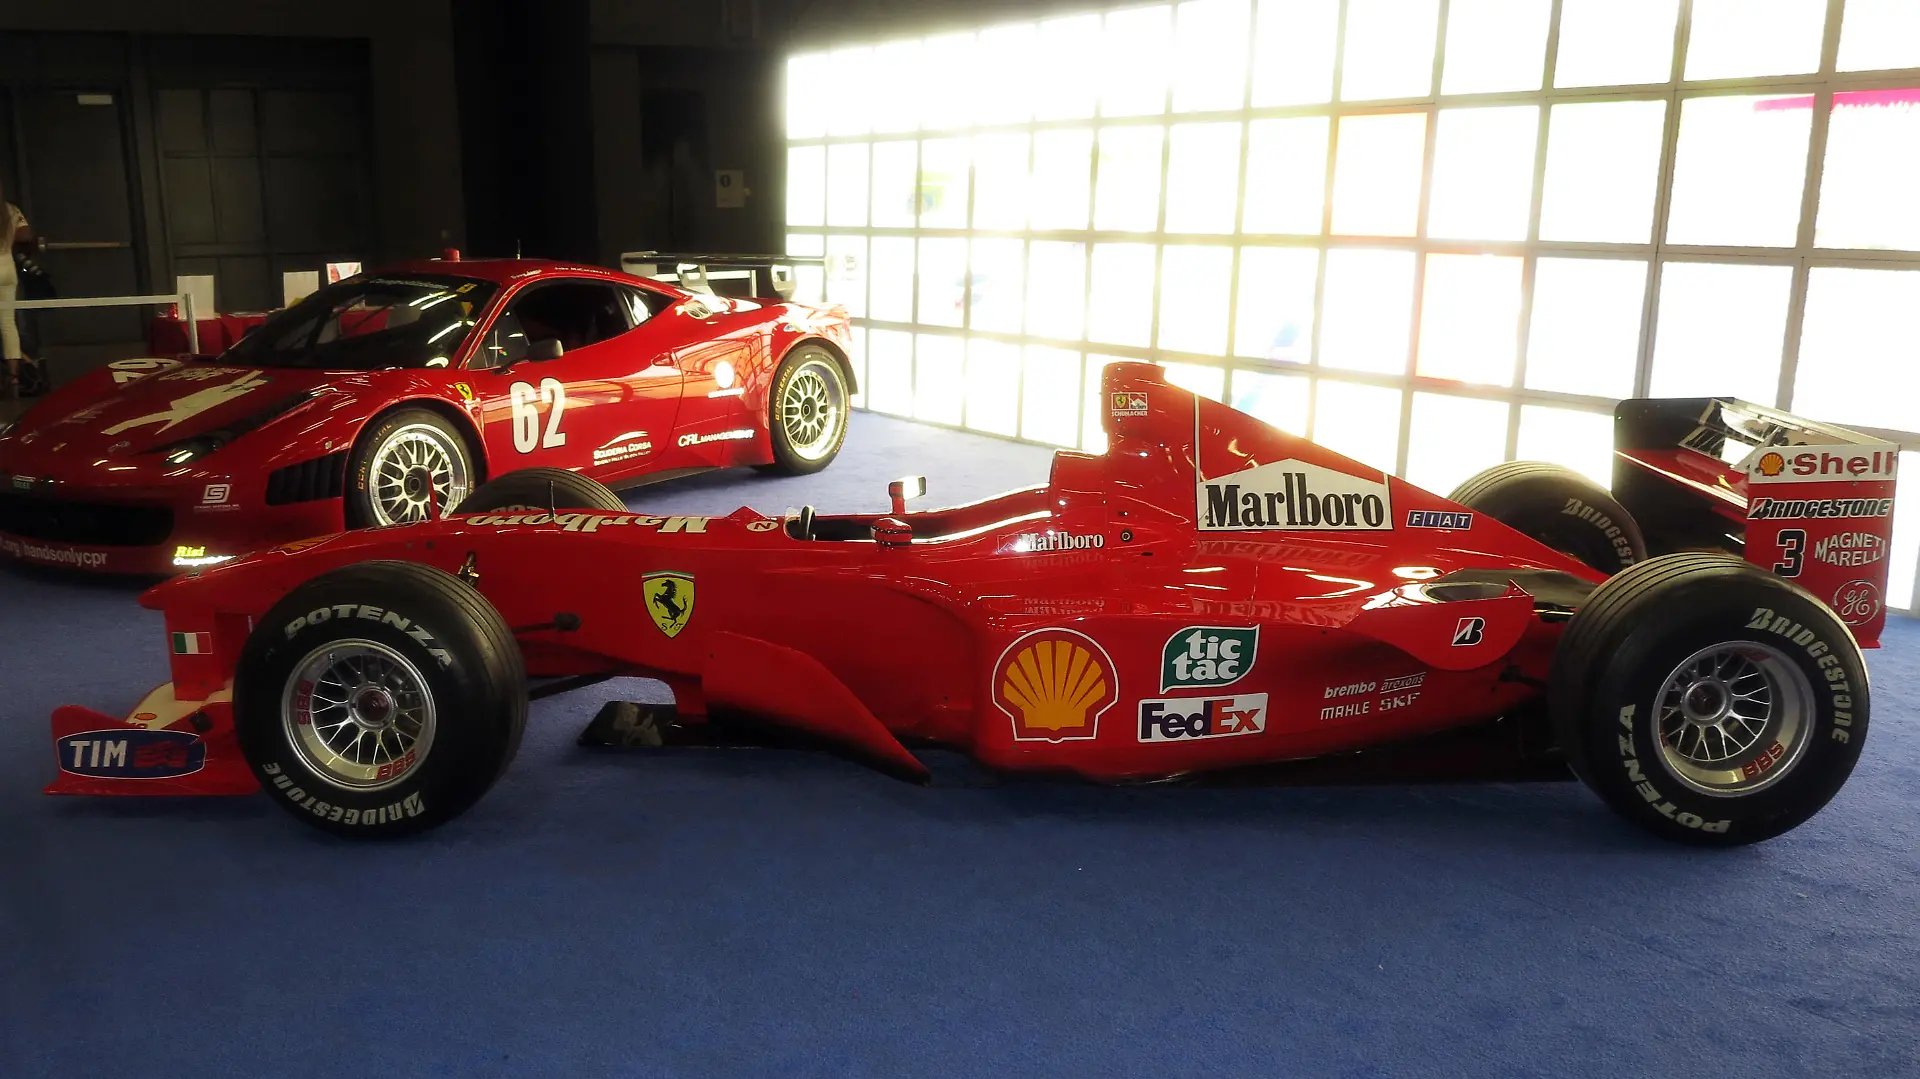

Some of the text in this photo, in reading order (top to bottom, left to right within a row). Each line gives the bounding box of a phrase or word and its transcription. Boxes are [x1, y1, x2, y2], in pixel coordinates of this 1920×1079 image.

[510, 377, 566, 454] 62
[678, 433, 700, 447] CRL
[1793, 452, 1893, 475] Shell
[1206, 473, 1384, 527] Marlboro
[1747, 498, 1893, 519] BRIDGESTONE
[466, 514, 711, 533] Marlboro
[1411, 513, 1468, 528] FIAT
[174, 546, 205, 557] Risi
[1020, 531, 1104, 552] Marlboro
[1773, 529, 1806, 577] 3
[1814, 532, 1886, 556] MAGNETI
[1814, 544, 1886, 567] MARELLI
[285, 604, 452, 671] POTENZA
[1185, 630, 1242, 659] tic
[1172, 652, 1239, 680] tac
[1746, 607, 1853, 744] BRIDGESTONE
[1324, 674, 1425, 698] brembo arexons
[1141, 700, 1261, 739] FedEx
[1320, 692, 1420, 720] MAHLE SKF
[69, 739, 128, 768] TIM
[1741, 740, 1785, 781] BBS
[1618, 703, 1732, 834] POTENZA
[262, 762, 426, 826] BRIDGESTONE
